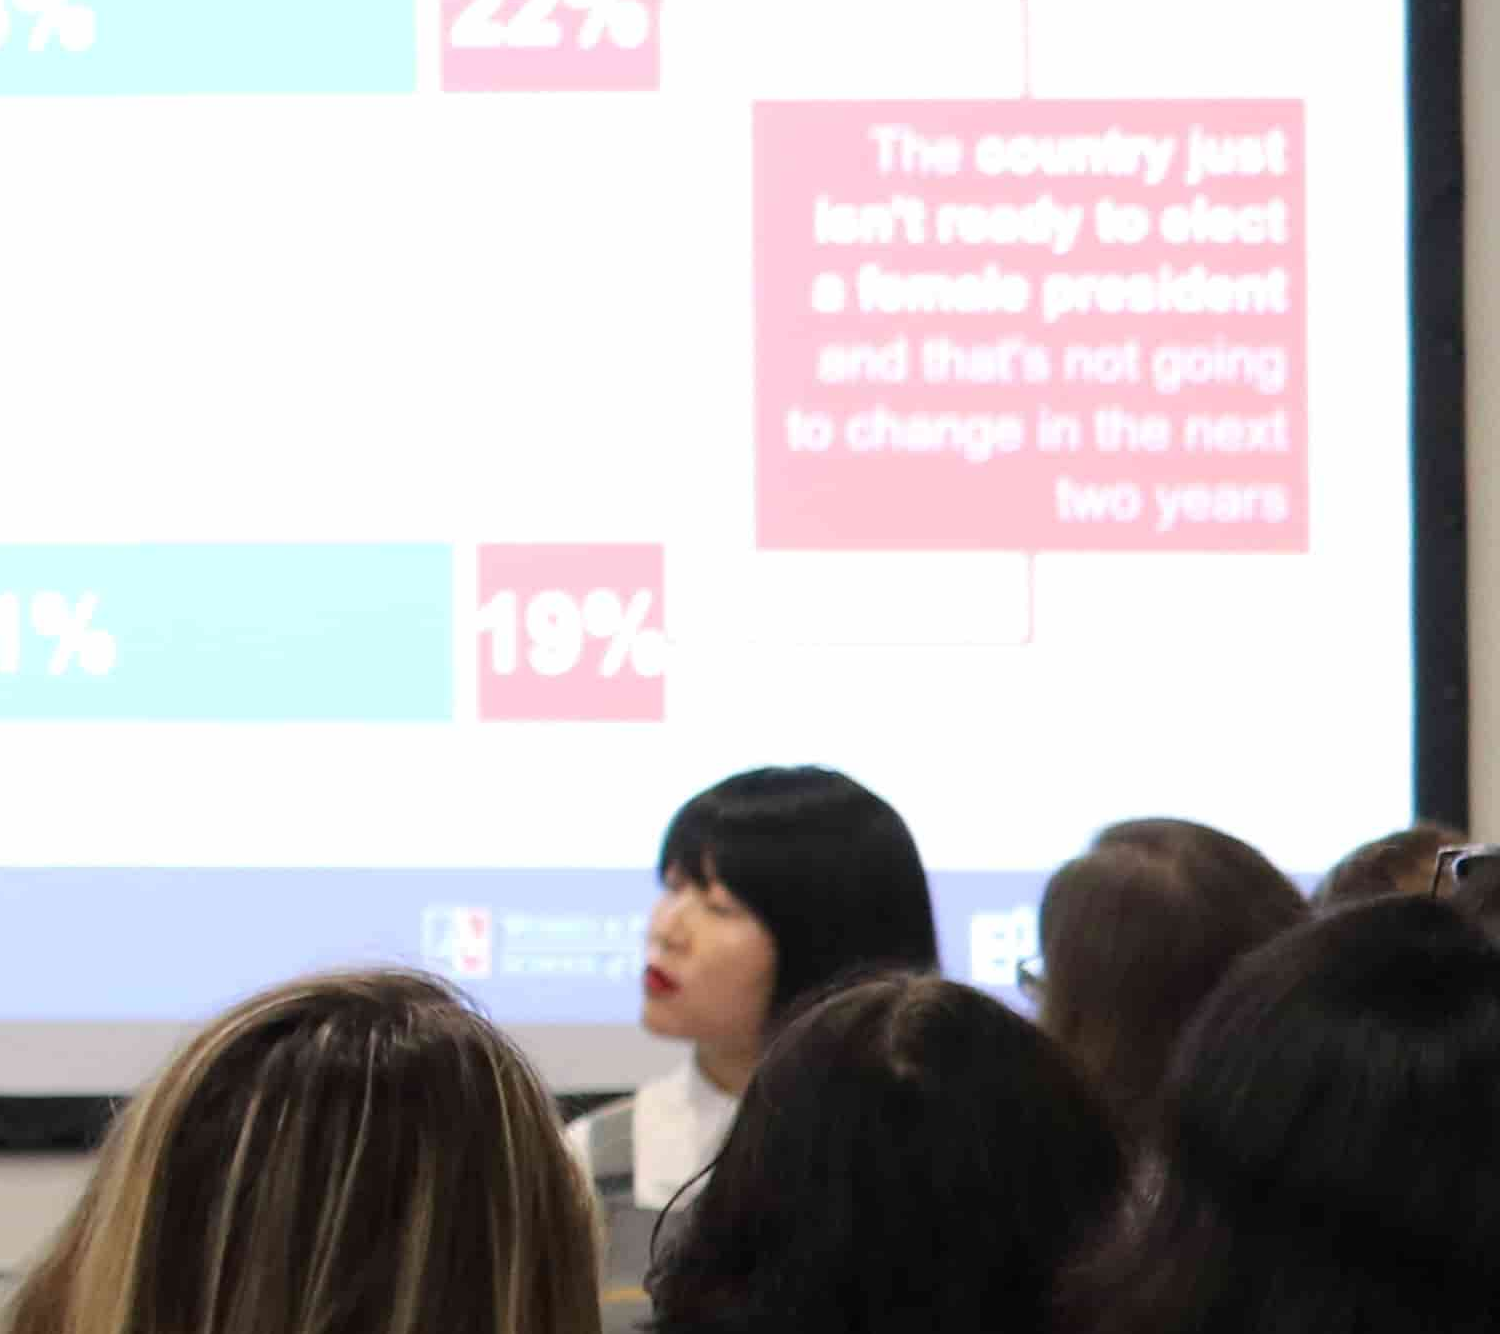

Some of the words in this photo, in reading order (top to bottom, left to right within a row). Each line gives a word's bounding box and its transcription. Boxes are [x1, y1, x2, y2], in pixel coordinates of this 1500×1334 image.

[869, 124, 964, 177] The
[974, 128, 1174, 185] country
[1184, 124, 1287, 185] just
[936, 193, 1084, 255] ready
[1094, 198, 1150, 244] to
[1160, 193, 1287, 244] elect
[810, 272, 845, 313] a
[856, 263, 1029, 314] female
[1041, 263, 1287, 323] president
[815, 336, 908, 384] and
[920, 336, 1051, 384] that's
[1063, 338, 1140, 384] not
[1151, 336, 1287, 395] going
[784, 406, 834, 451] to
[844, 403, 1026, 462] change
[1035, 404, 1081, 451] in
[1094, 404, 1172, 451] the
[1182, 407, 1287, 453] next
[1054, 477, 1142, 522] two
[1152, 481, 1288, 535] years
[473, 587, 668, 678] 19%
